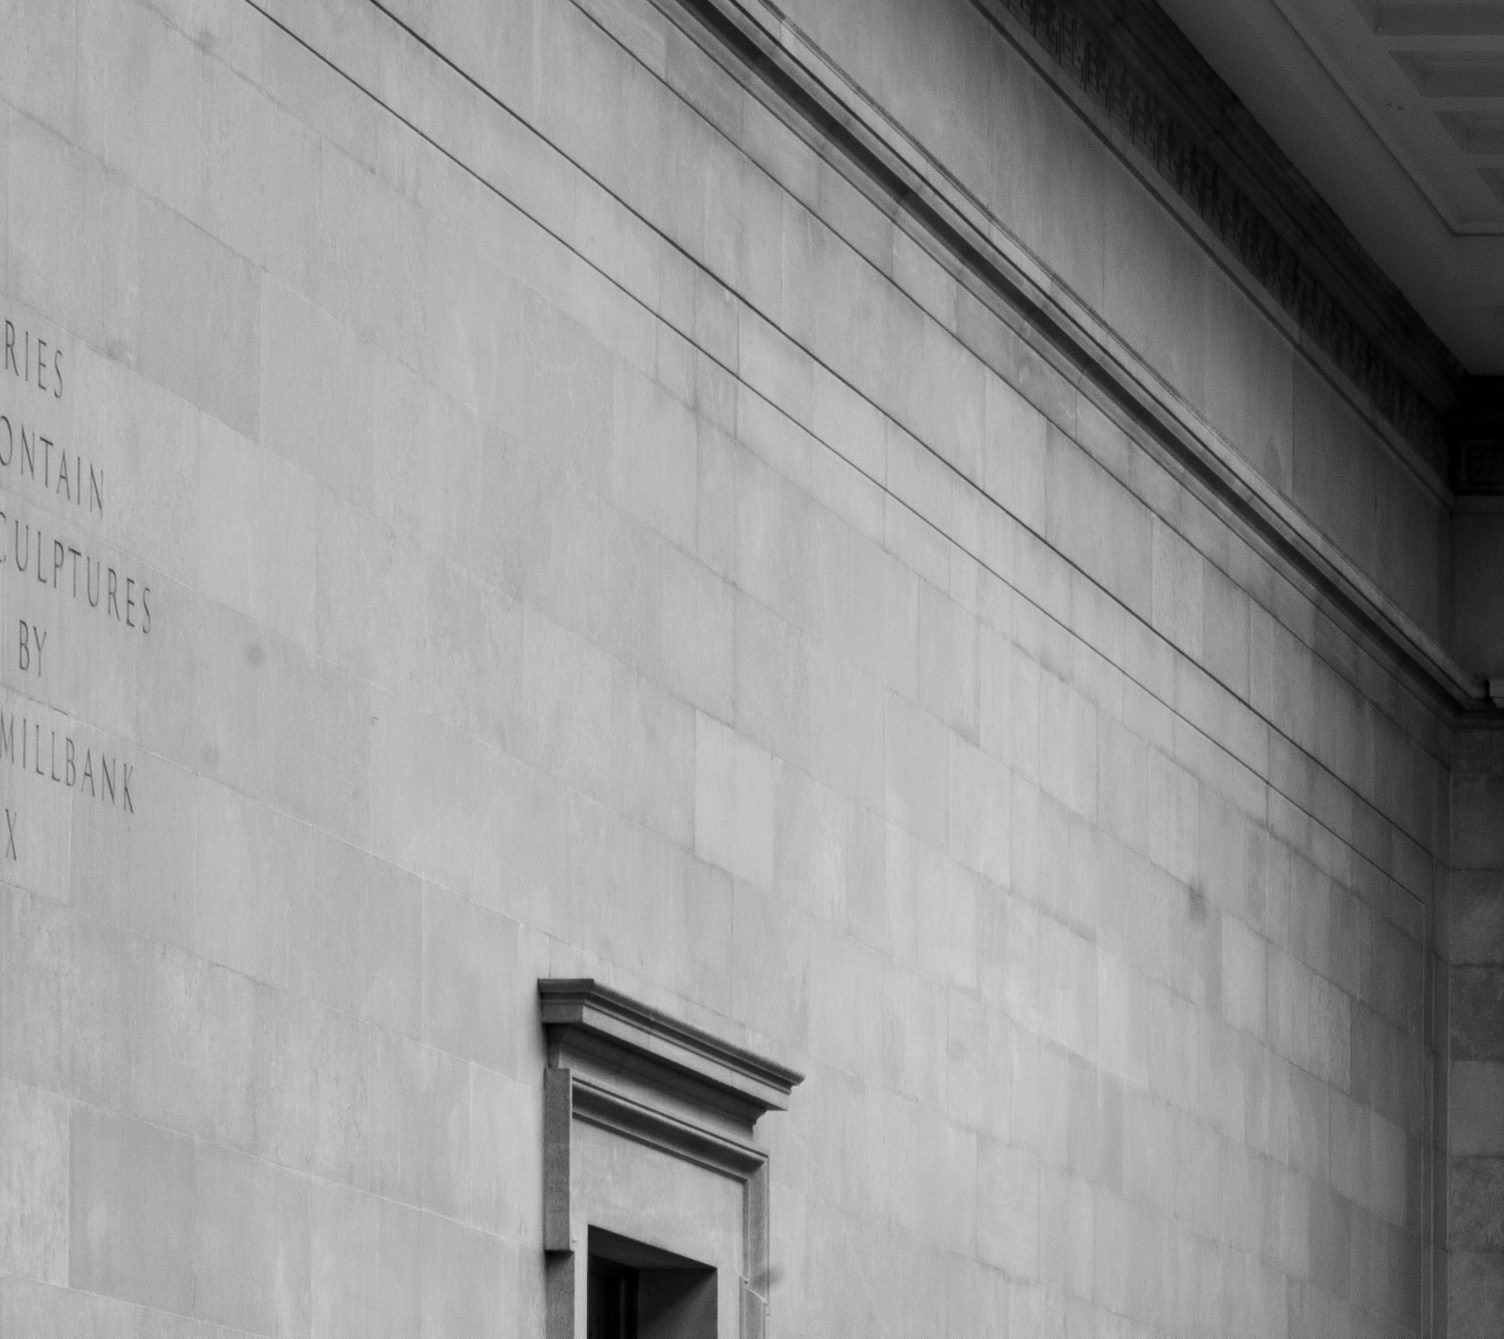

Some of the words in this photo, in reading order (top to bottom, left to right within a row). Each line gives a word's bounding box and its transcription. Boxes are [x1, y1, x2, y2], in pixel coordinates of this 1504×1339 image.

[4, 318, 64, 399] RIES
[18, 619, 48, 678] BY
[0, 707, 135, 814] MILLBANK
